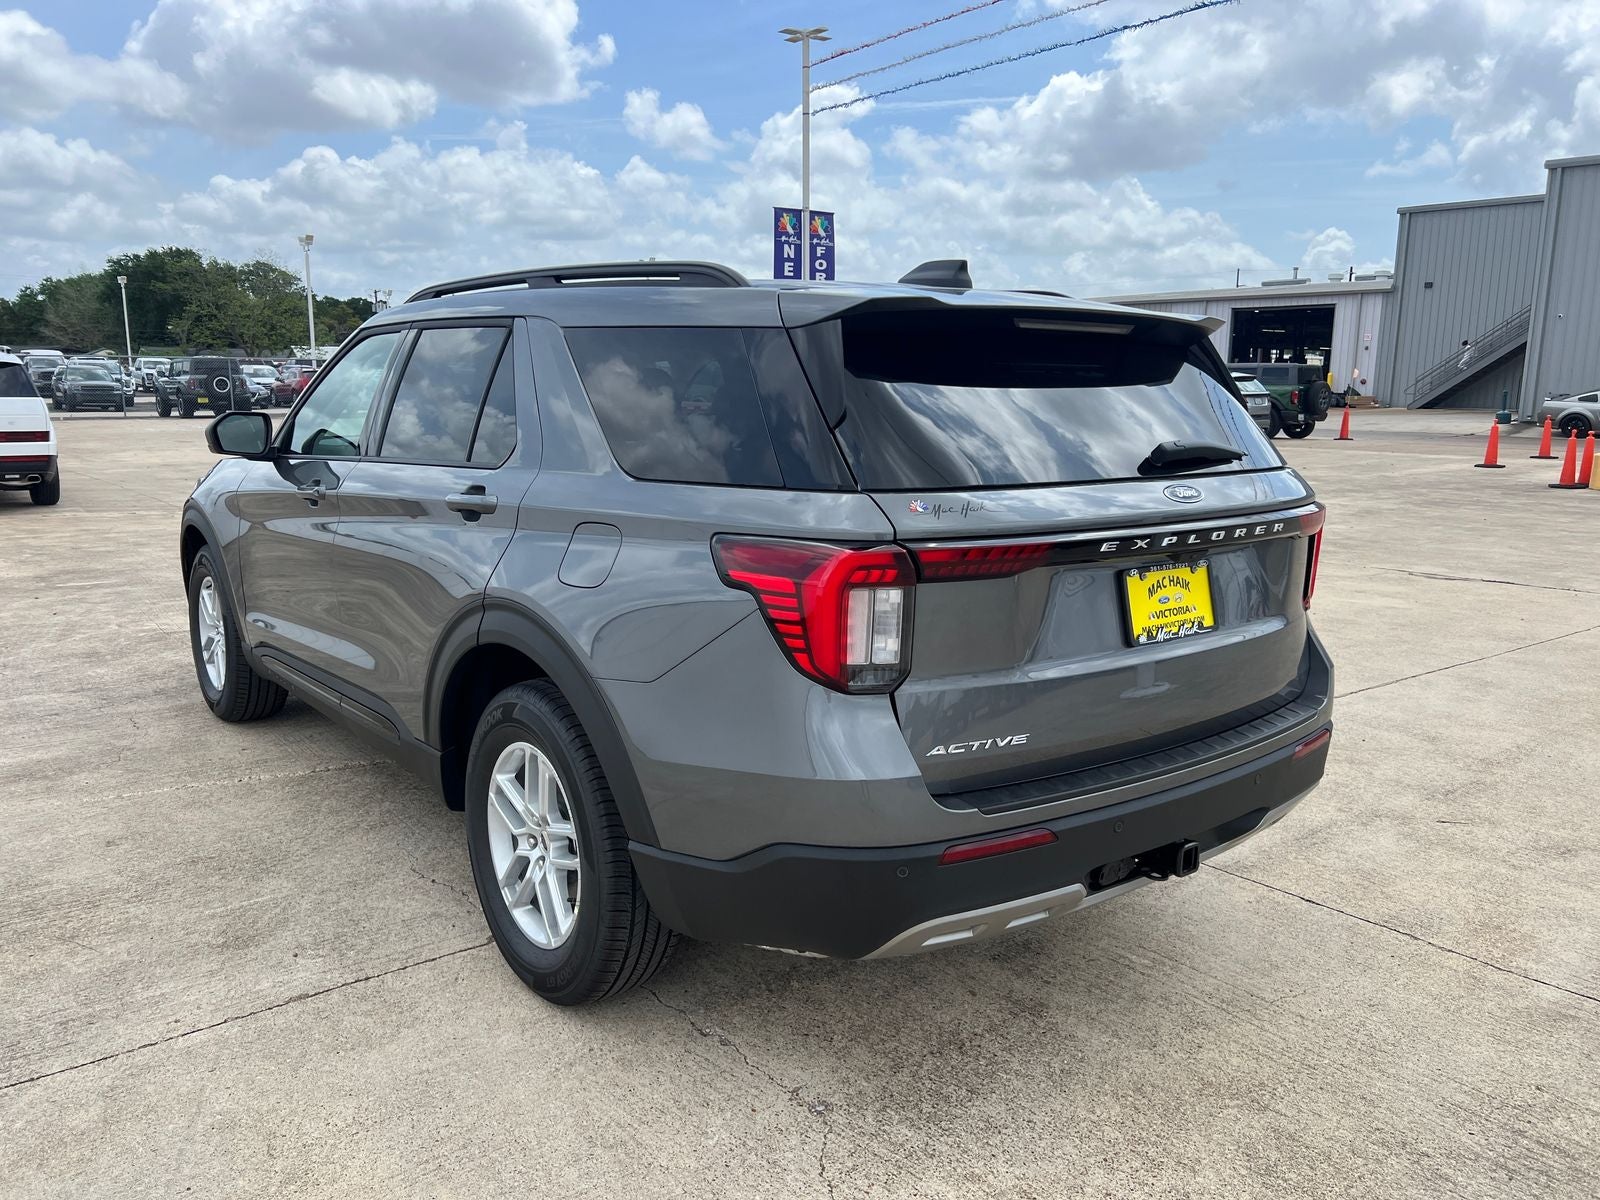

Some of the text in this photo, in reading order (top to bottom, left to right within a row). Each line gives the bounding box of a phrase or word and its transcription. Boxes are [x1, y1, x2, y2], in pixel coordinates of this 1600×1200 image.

[1174, 486, 1198, 498] Ford
[930, 501, 987, 520] Mac Haik
[1100, 522, 1284, 552] EXPLORER
[1147, 575, 1191, 600] MAC HAIK
[1155, 605, 1190, 619] VICTORIA
[1156, 622, 1204, 642] Mac Haik
[925, 733, 1031, 757] ACTIVE
